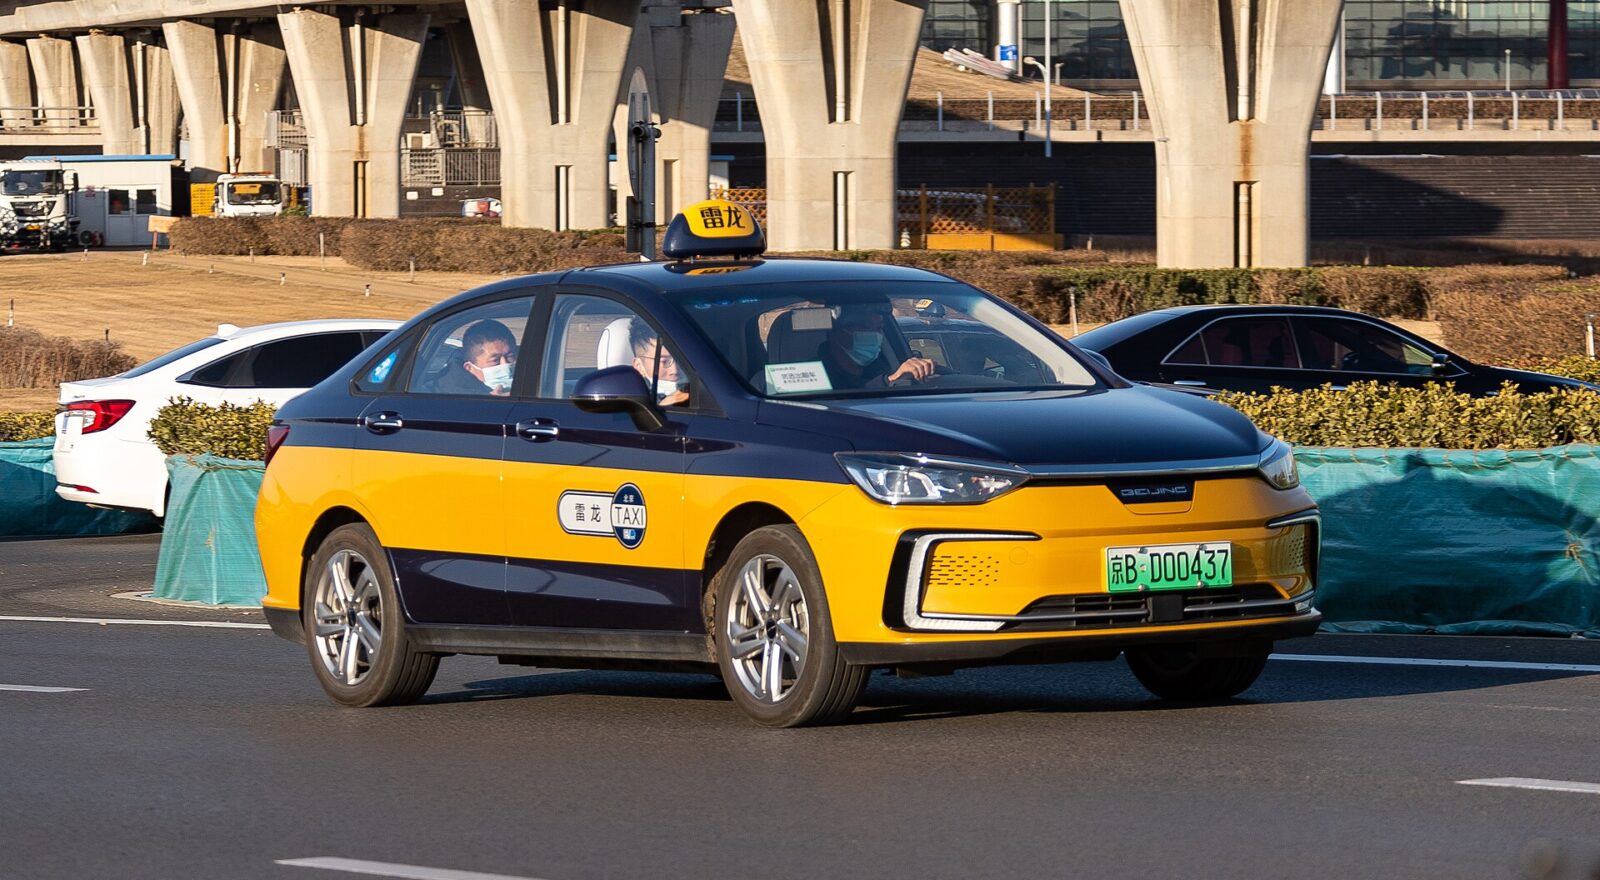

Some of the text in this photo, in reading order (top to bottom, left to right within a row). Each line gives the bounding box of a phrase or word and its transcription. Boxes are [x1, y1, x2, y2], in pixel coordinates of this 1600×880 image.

[699, 206, 746, 229] 雷龙
[1121, 486, 1187, 496] BEIJING
[575, 503, 601, 523] 雷龙
[614, 506, 644, 526] TAXI
